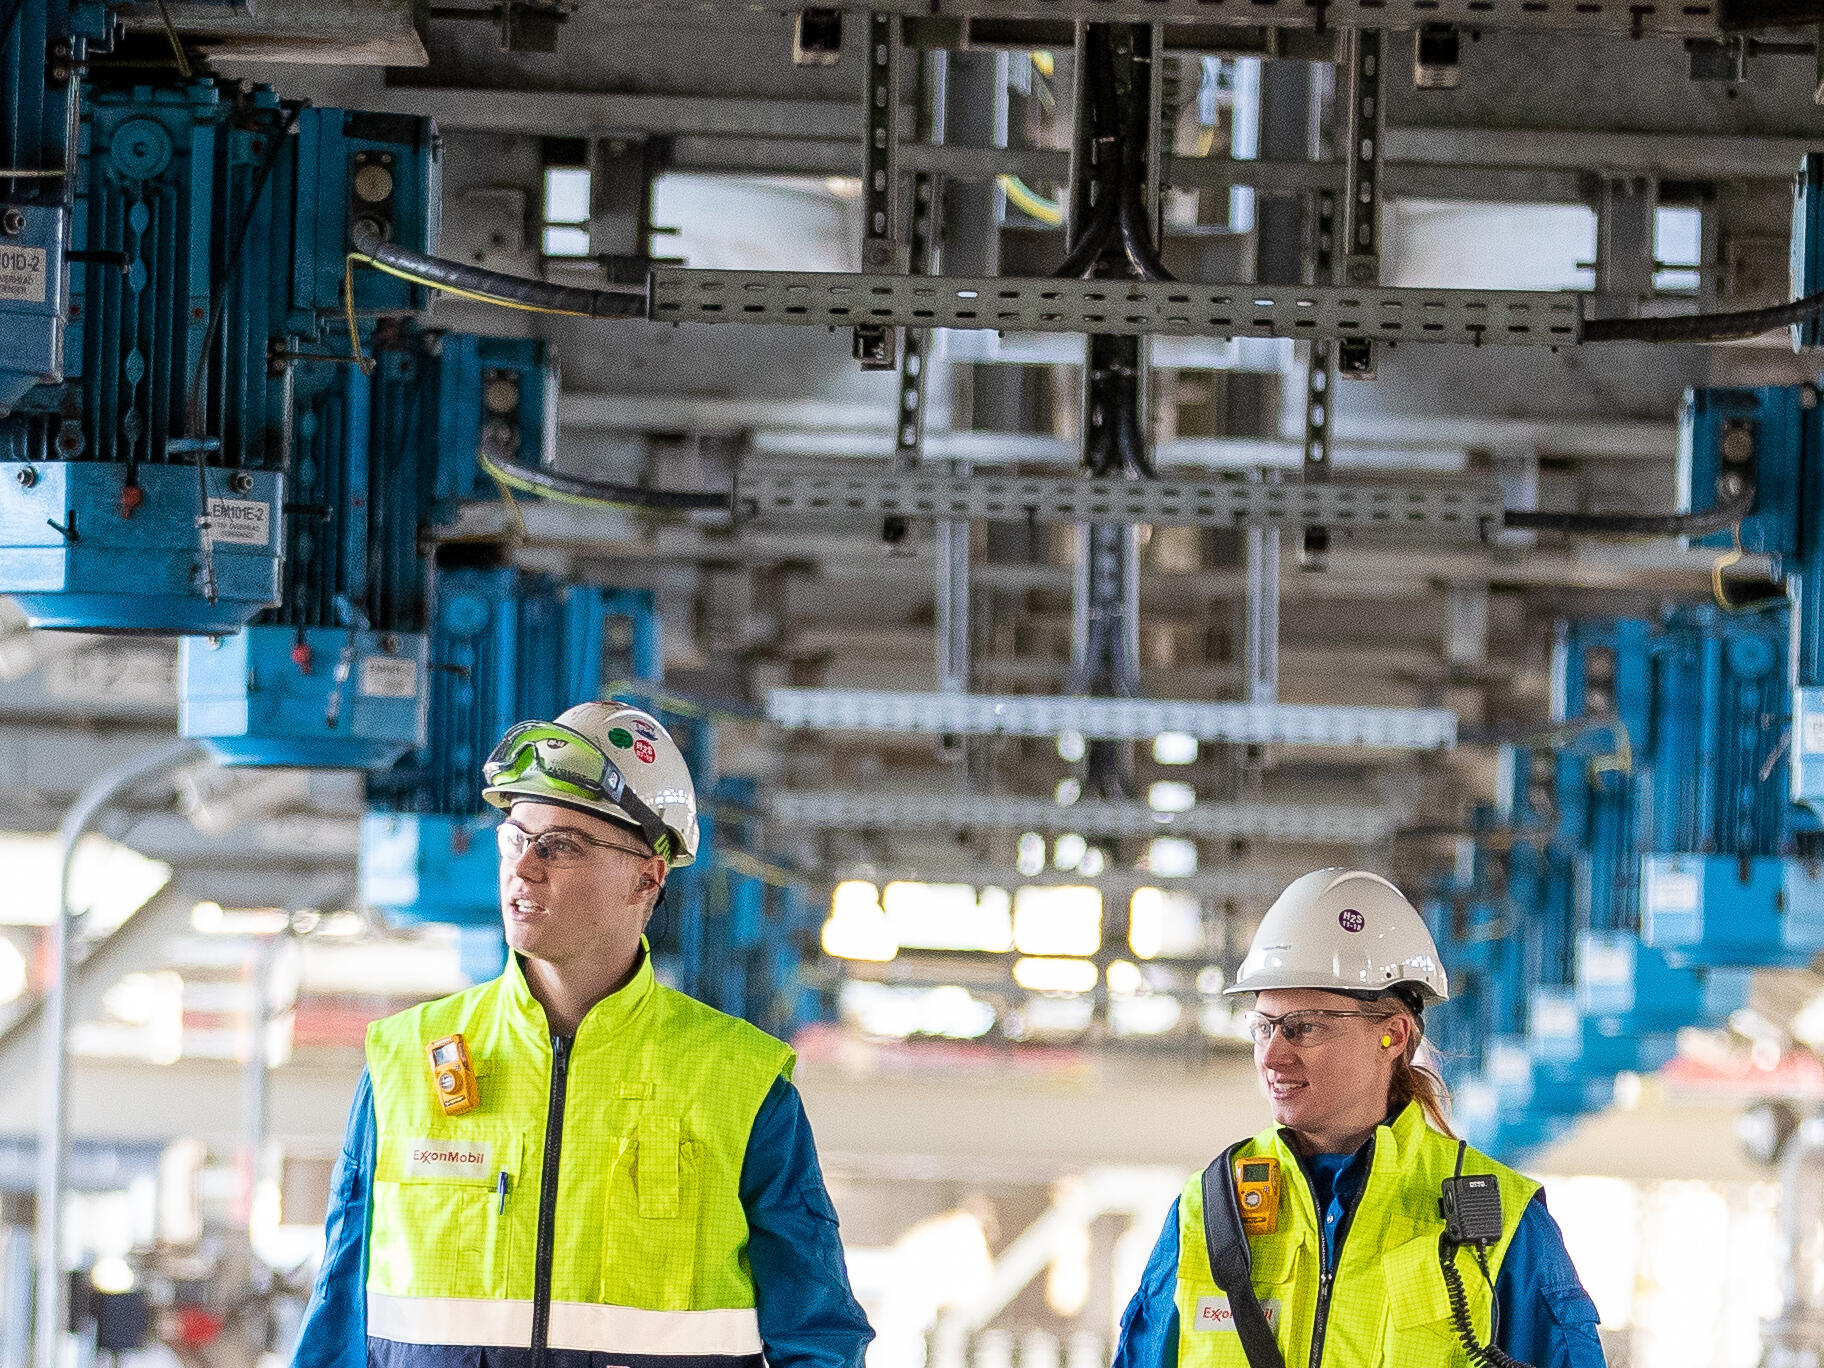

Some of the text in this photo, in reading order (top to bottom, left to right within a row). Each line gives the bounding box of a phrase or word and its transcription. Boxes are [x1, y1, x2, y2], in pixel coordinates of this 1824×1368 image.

[1343, 911, 1363, 924] H2S
[413, 1149, 485, 1165] ExxonMobil
[1203, 1306, 1274, 1323] Exxoil
